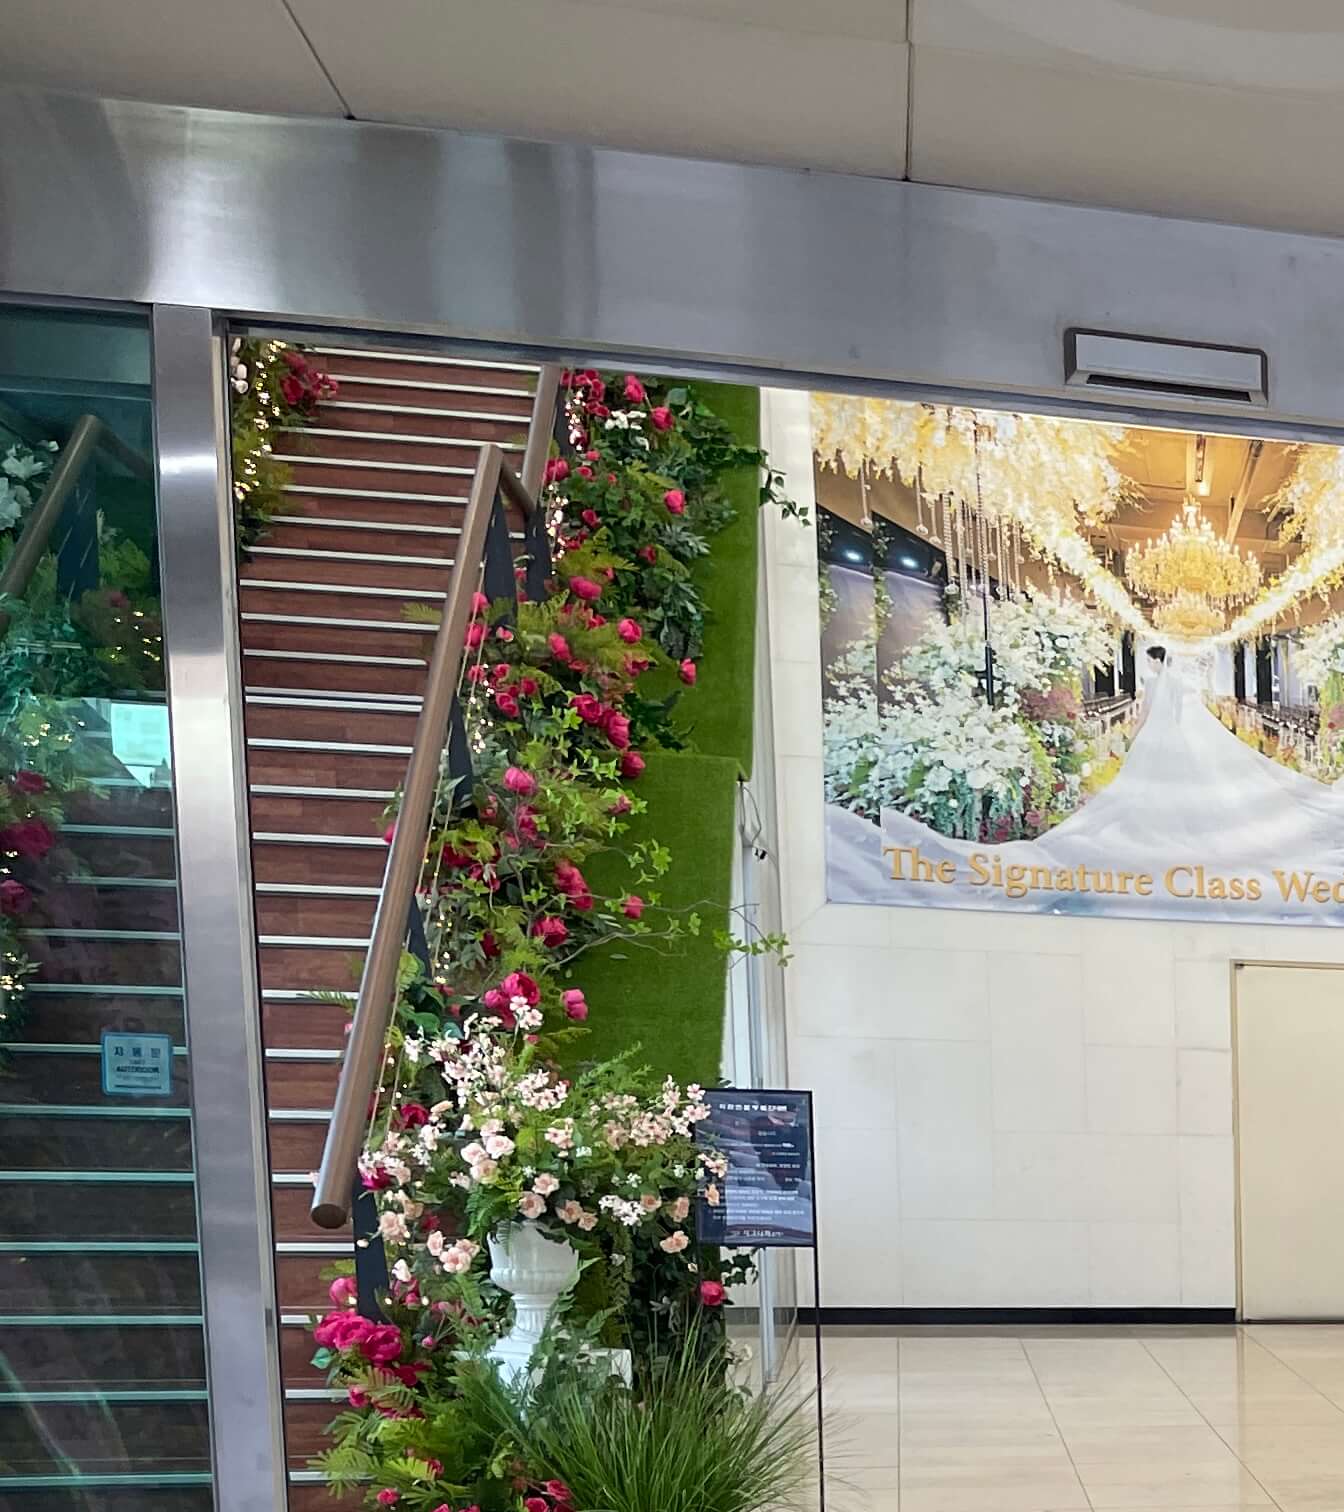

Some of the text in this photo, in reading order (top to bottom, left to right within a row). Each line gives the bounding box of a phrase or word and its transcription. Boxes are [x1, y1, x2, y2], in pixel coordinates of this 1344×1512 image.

[883, 846, 957, 885] The
[968, 854, 1154, 898] Signature
[1164, 865, 1263, 900] Class
